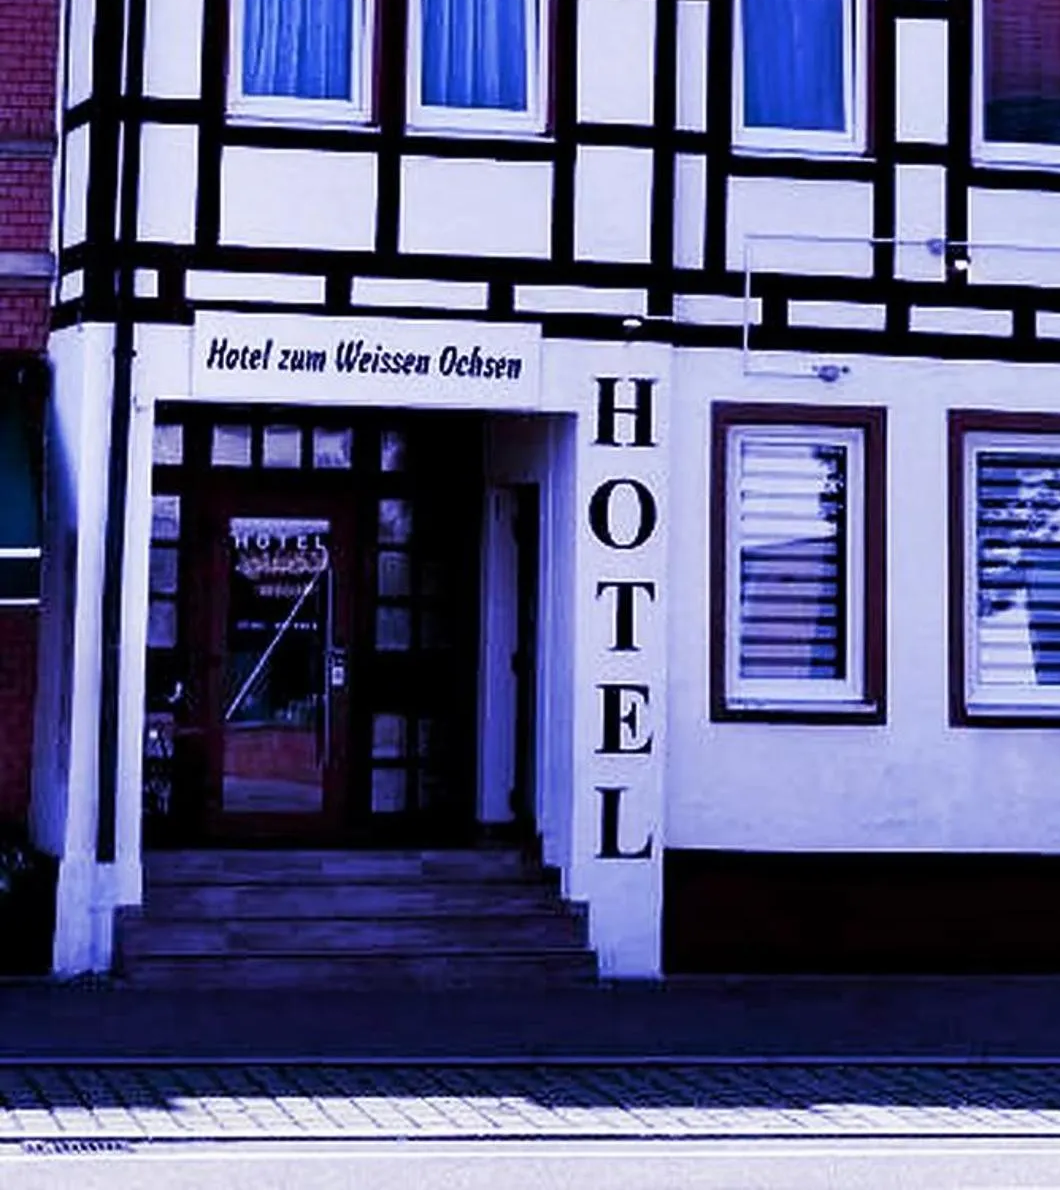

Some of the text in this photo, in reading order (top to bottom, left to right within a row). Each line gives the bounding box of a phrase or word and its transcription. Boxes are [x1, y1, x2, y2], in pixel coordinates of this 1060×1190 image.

[206, 338, 523, 380] Hotel zum Weissen Ochsen
[234, 534, 325, 550] HOTEL
[588, 376, 660, 861] HOTEL
